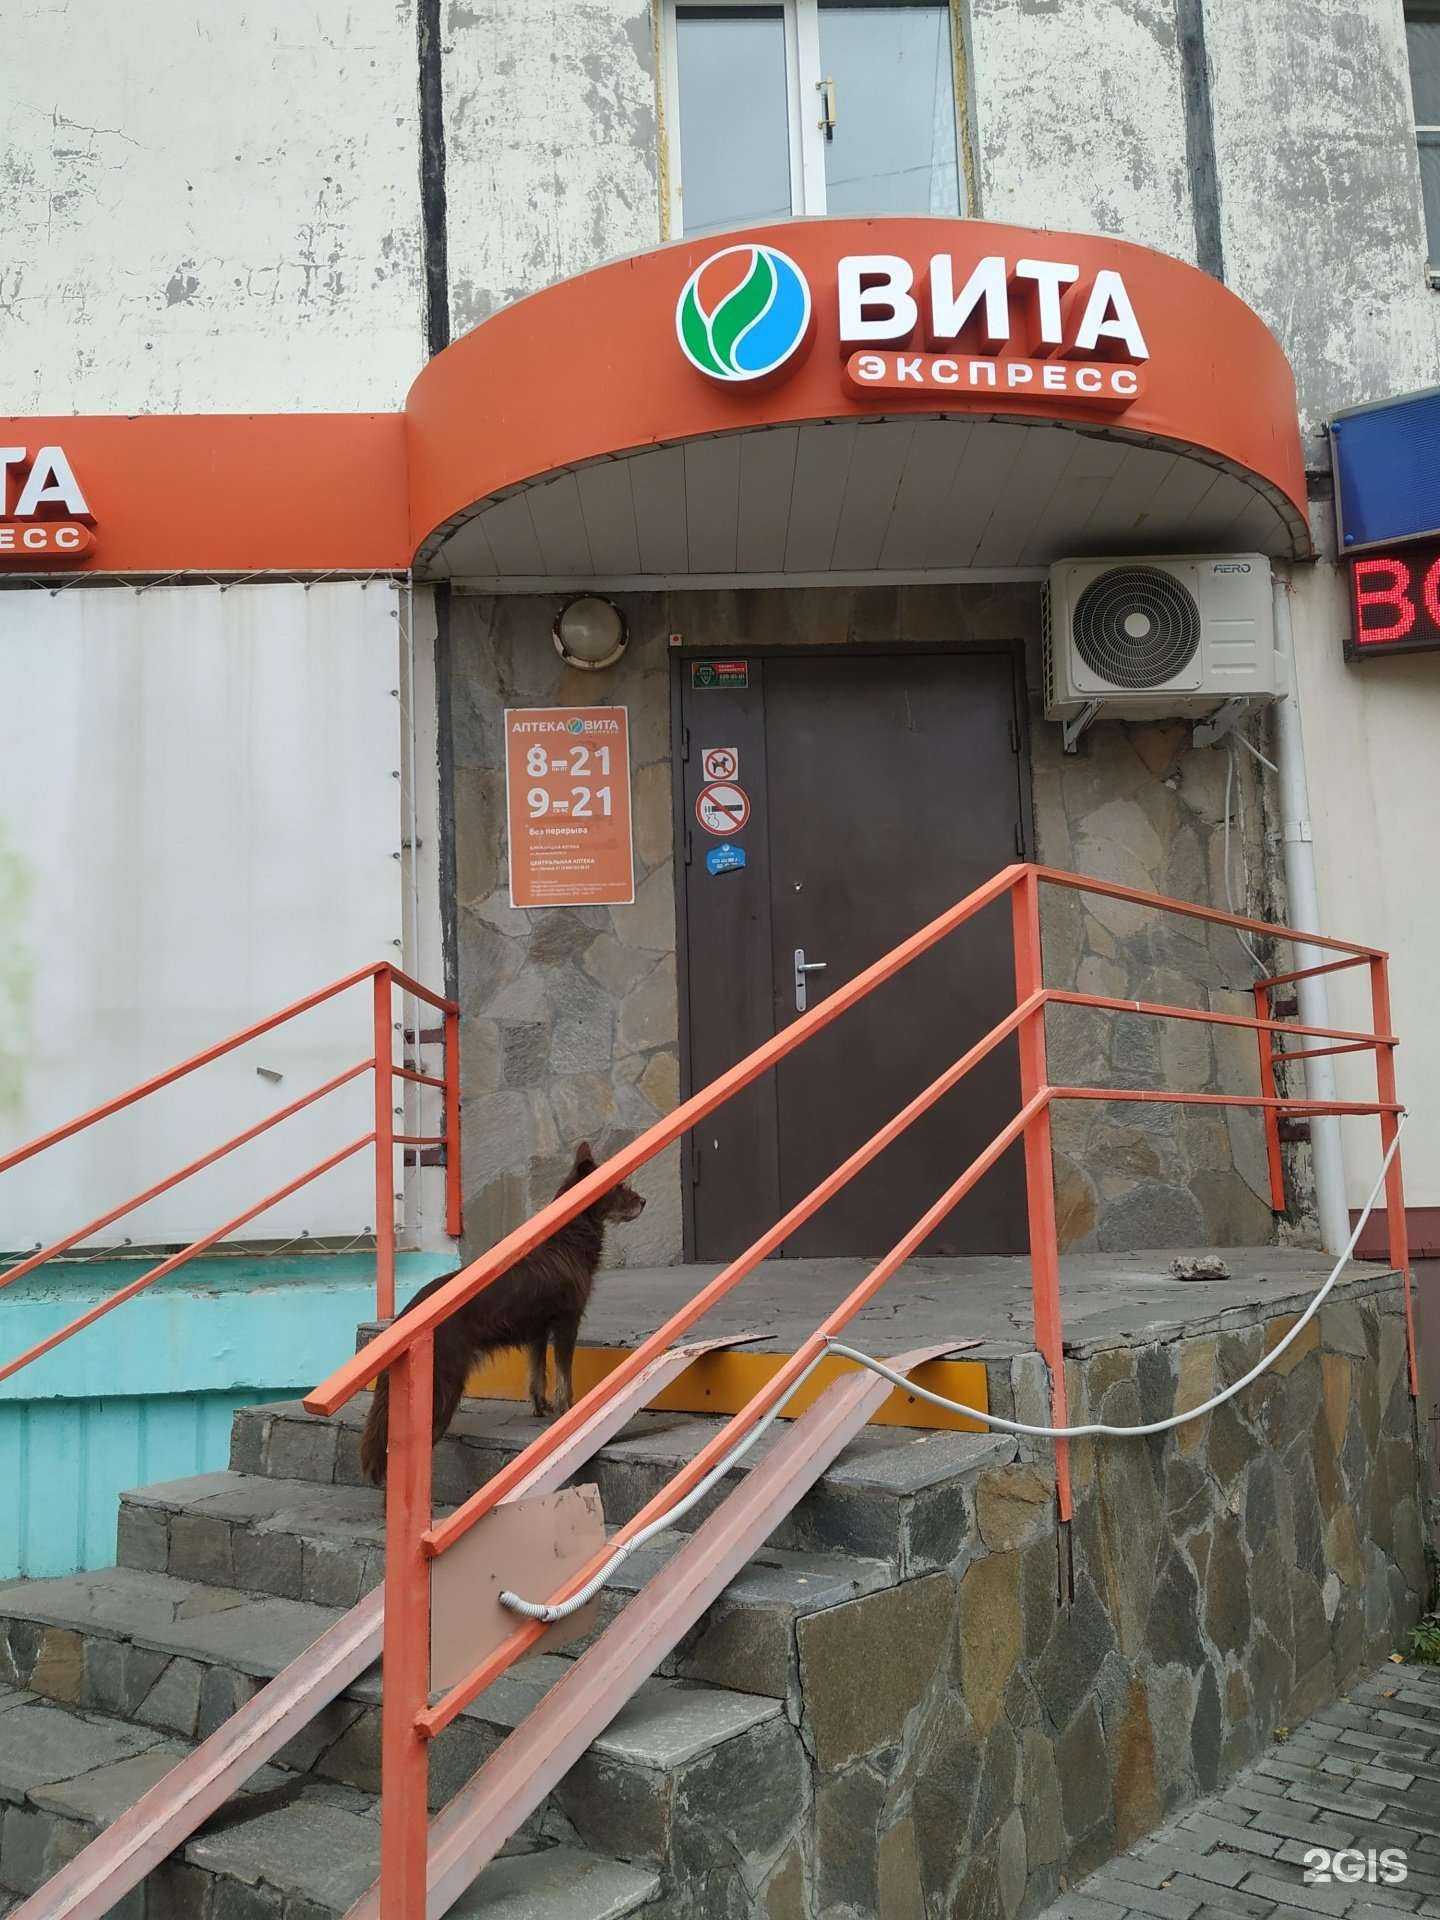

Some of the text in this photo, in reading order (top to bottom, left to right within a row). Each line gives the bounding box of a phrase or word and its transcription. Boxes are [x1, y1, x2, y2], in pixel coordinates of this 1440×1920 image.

[839, 253, 1150, 360] ВИТА
[857, 354, 1138, 395] ЭКСПРЕСС
[1213, 563, 1251, 574] AERO
[512, 719, 619, 733] АПТЕКА ВИТА
[527, 786, 612, 818] 9-21
